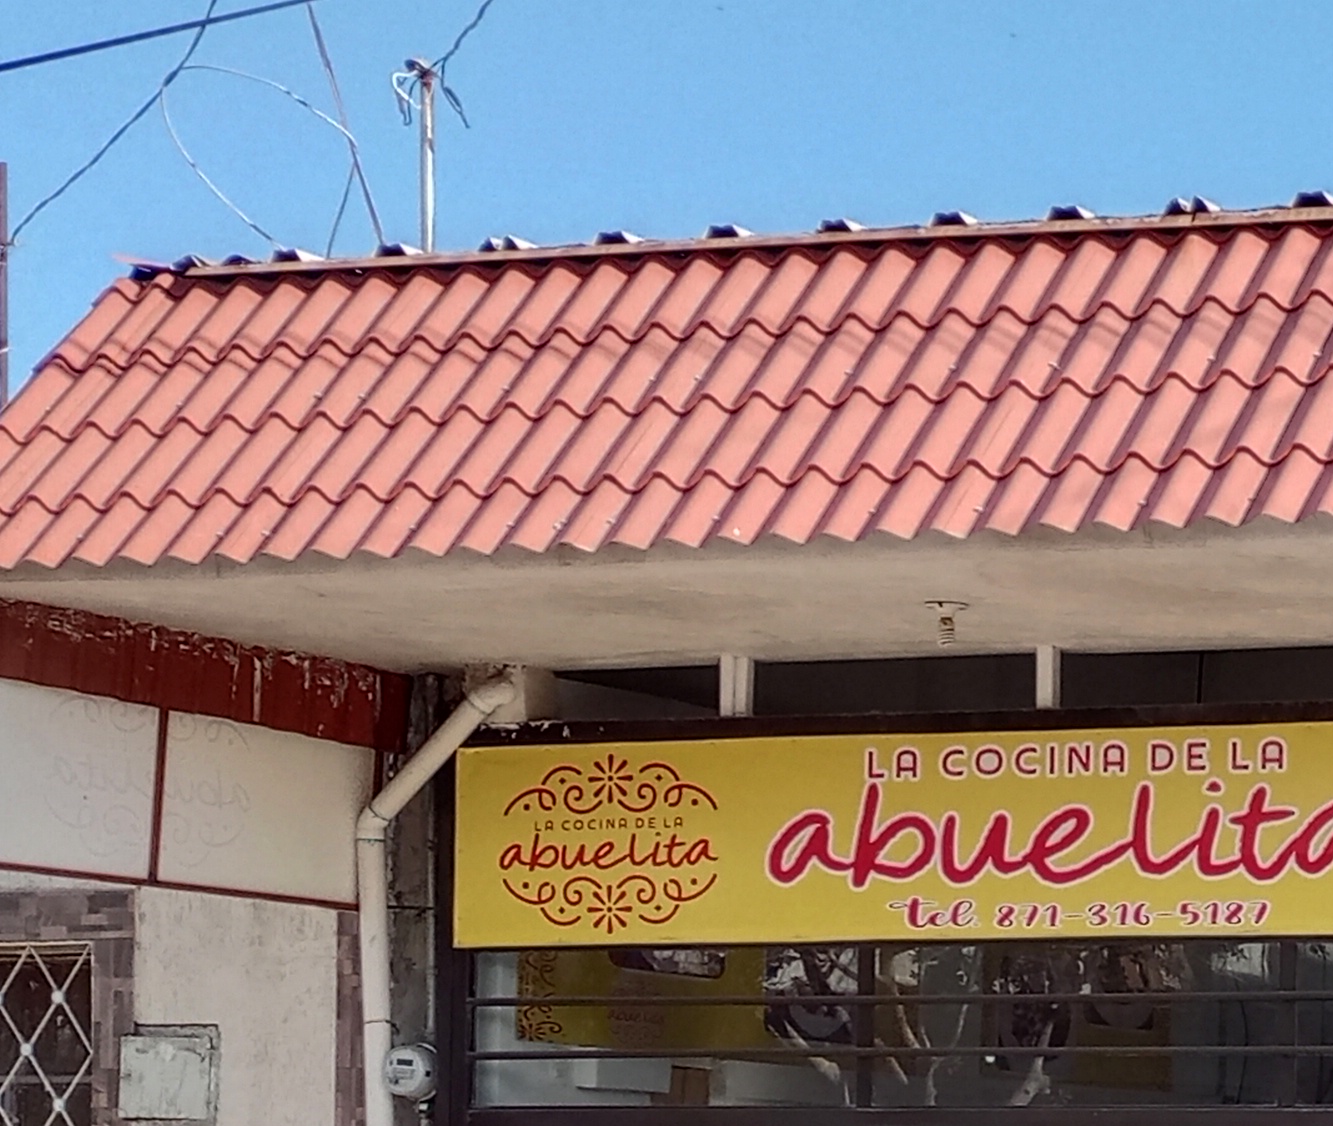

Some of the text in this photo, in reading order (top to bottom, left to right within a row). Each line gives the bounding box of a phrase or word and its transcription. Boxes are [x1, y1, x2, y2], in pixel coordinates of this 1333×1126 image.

[867, 740, 1285, 779] LA COCINA DE LA
[533, 816, 684, 832] LA COCINA DE LA
[498, 830, 719, 872] abuelita
[996, 900, 1270, 928] 871-316-5187
